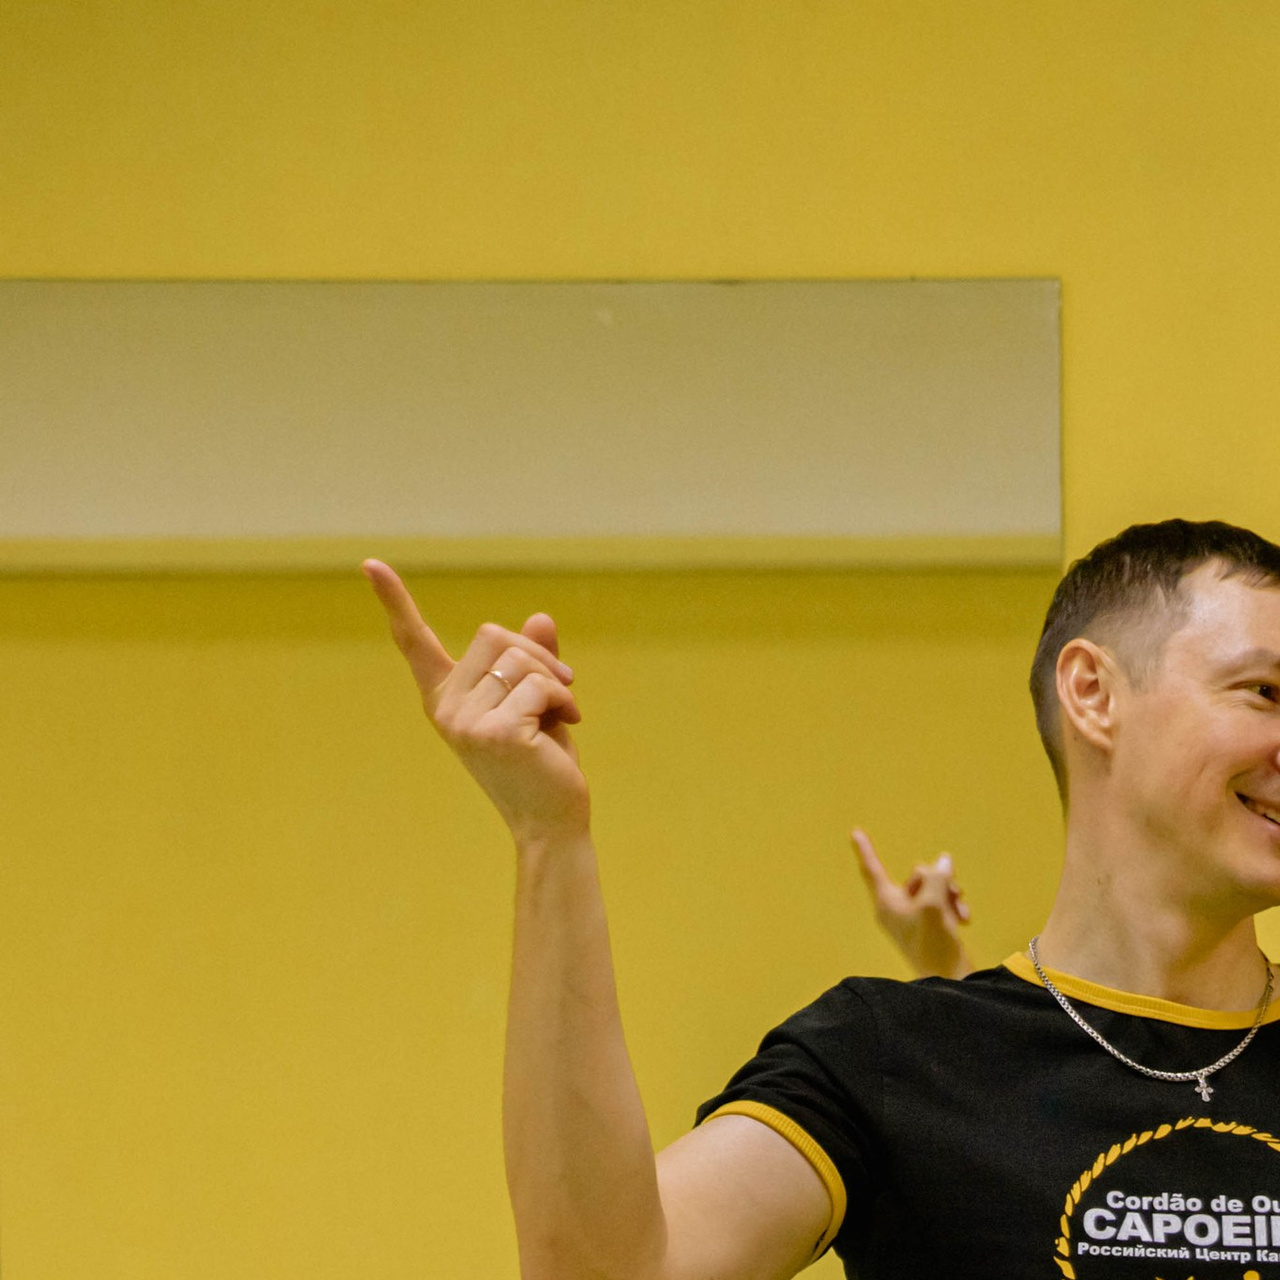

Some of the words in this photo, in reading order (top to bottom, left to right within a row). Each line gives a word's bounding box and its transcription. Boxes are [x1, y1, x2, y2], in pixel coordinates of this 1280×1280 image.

[1106, 1190, 1203, 1212] Cordão
[1210, 1194, 1244, 1214] de
[1077, 1242, 1190, 1260] Российский
[1195, 1247, 1251, 1265] Центр
